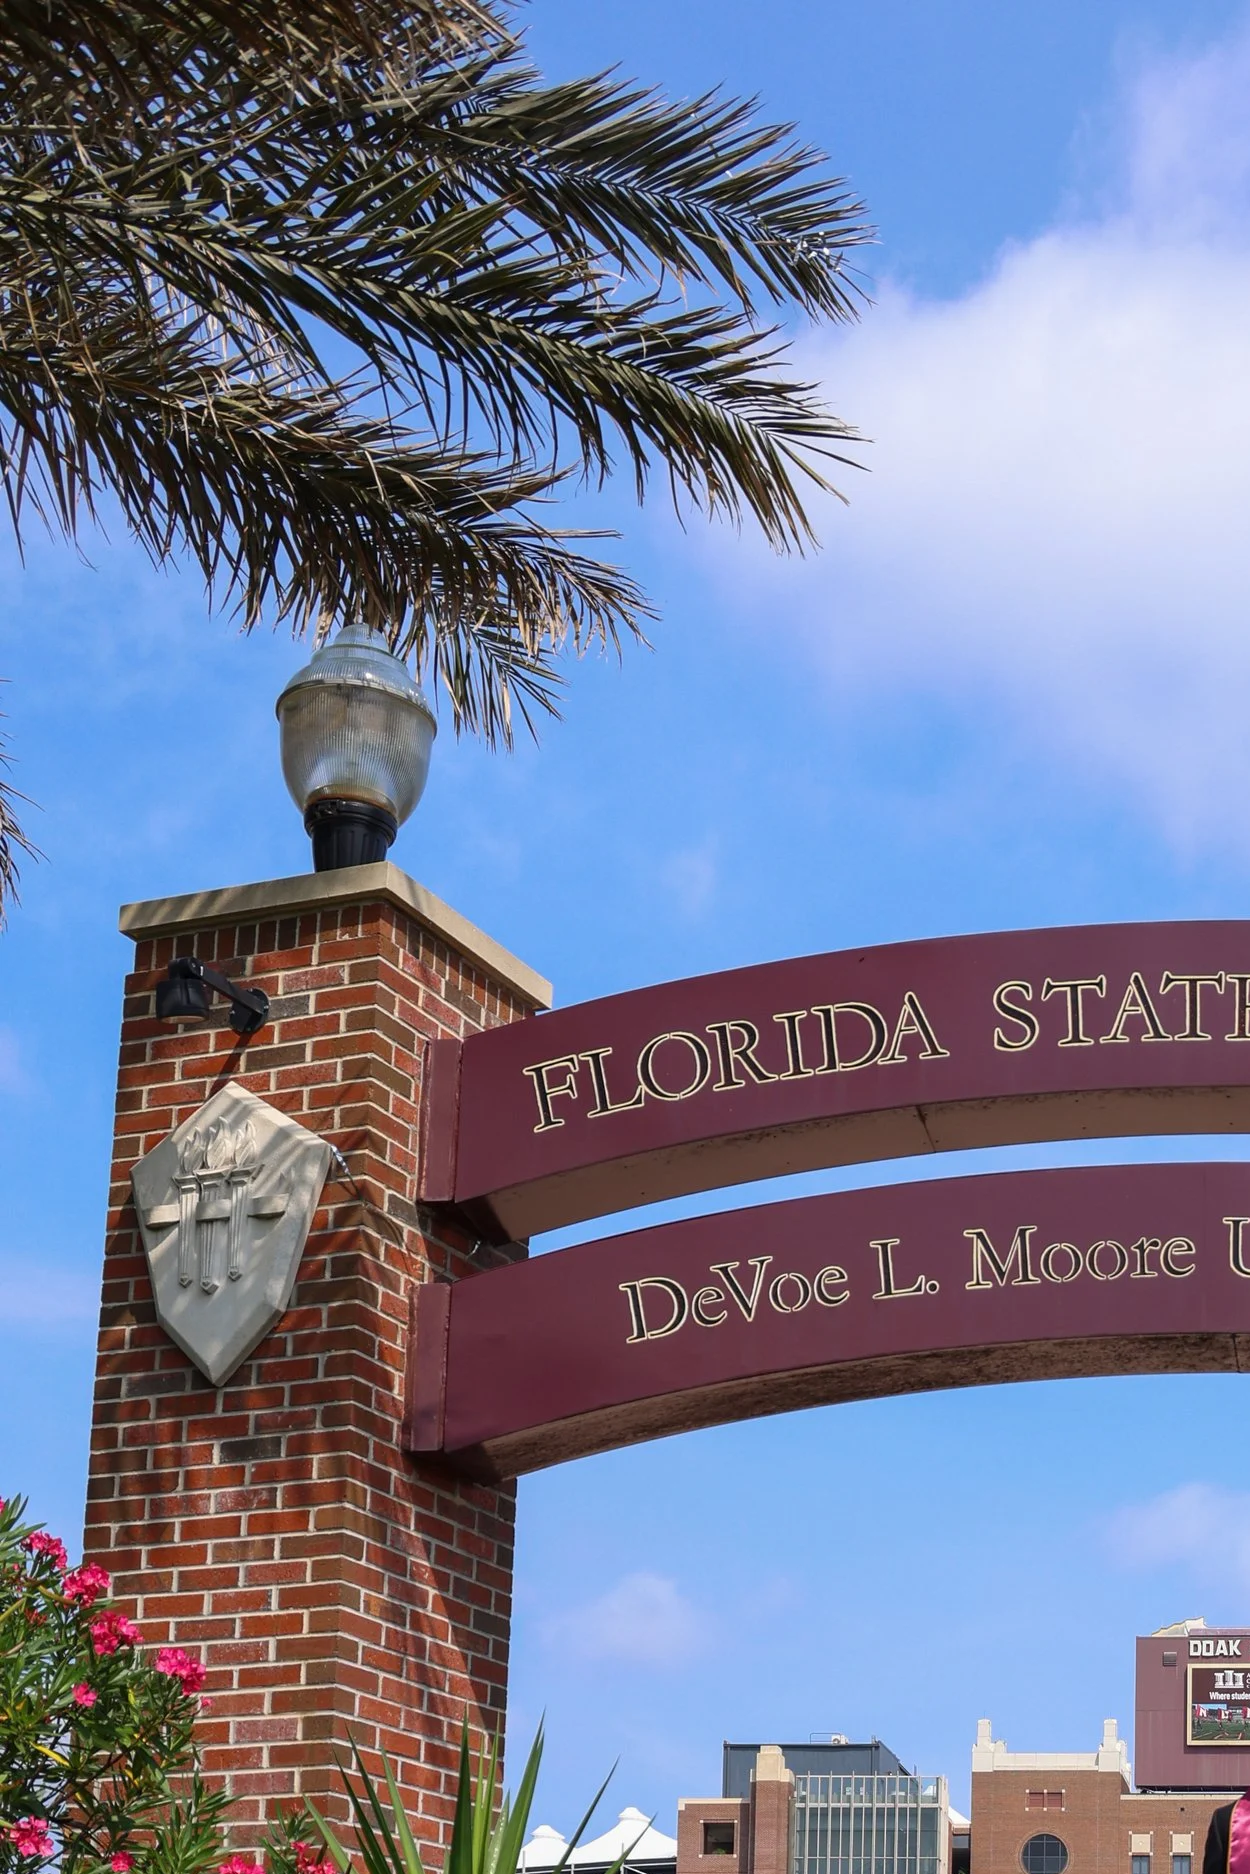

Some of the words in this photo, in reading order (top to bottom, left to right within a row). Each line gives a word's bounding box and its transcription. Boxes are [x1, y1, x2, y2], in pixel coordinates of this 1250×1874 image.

[523, 991, 949, 1134] FLORIDA
[619, 1255, 849, 1344] DeVoe
[869, 1238, 940, 1300] L.
[963, 1225, 1197, 1290] Moore
[1189, 1639, 1242, 1657] DOAK
[1209, 1691, 1230, 1700] Where
